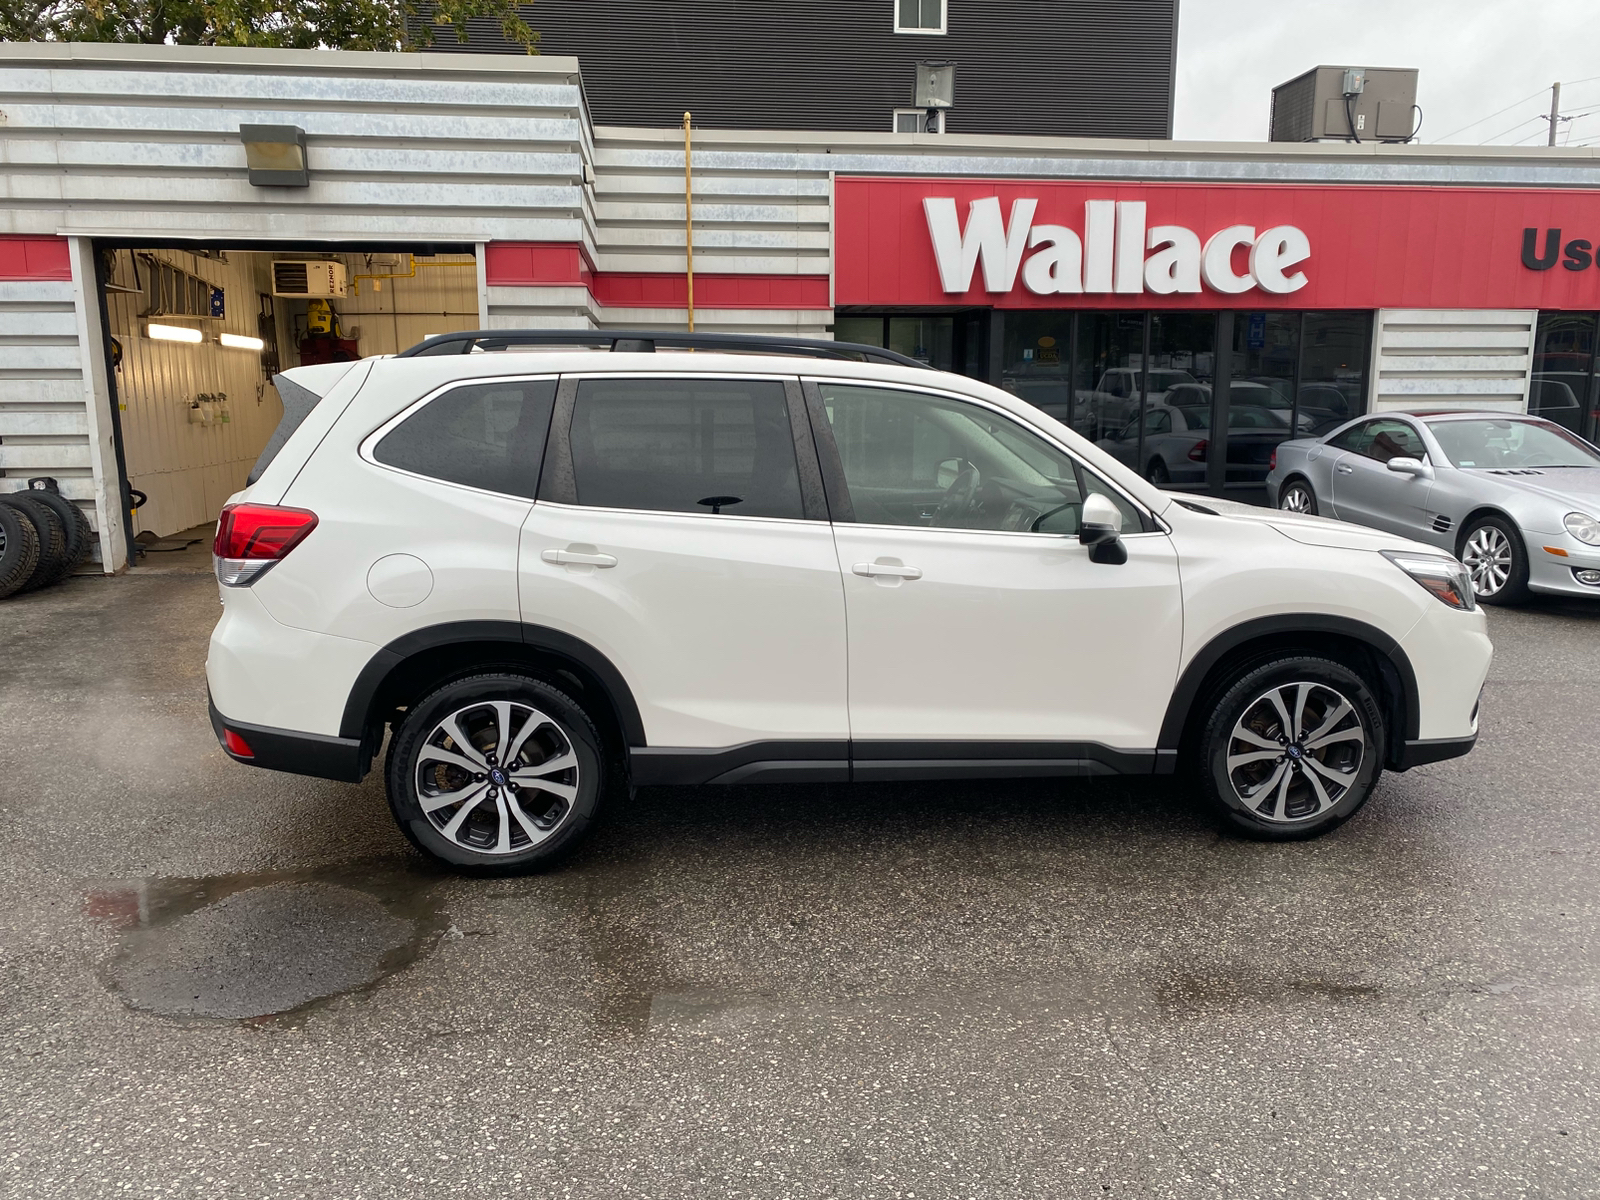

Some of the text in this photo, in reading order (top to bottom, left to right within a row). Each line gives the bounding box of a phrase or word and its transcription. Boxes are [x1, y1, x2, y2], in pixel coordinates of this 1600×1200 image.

[922, 196, 1311, 294] Wallace
[1521, 227, 1600, 271] Us
[1364, 697, 1381, 729] PIRELLI
